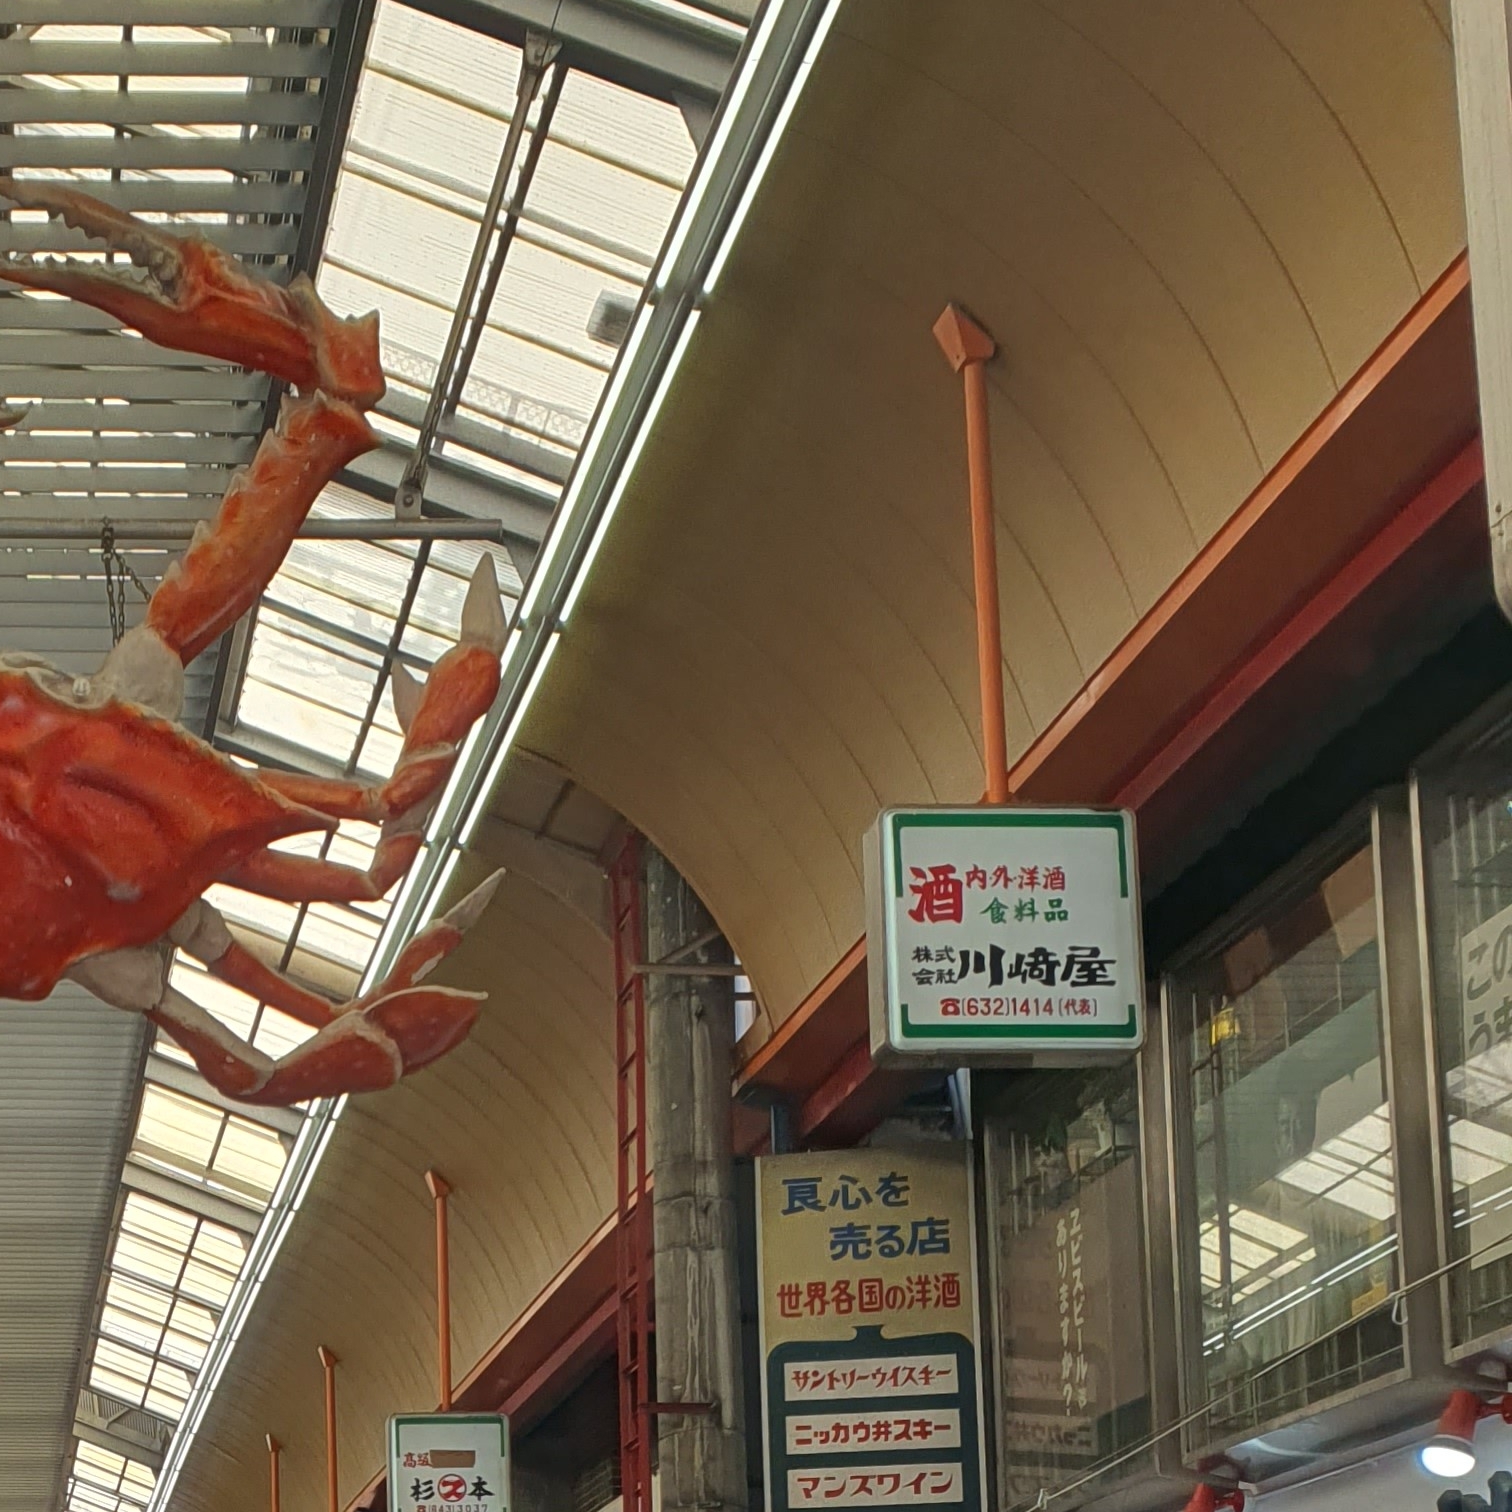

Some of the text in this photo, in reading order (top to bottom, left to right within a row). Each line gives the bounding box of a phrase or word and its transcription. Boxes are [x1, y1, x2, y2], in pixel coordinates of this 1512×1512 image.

[908, 863, 964, 924] 酒
[980, 897, 1070, 924] 食料品
[781, 1171, 911, 1216] 良心を
[828, 1217, 951, 1262] 売る店
[777, 1271, 962, 1319] 世界各国の洋酒
[791, 1366, 953, 1393] サントリーウイスキー
[797, 1471, 954, 1501] マンズワイン
